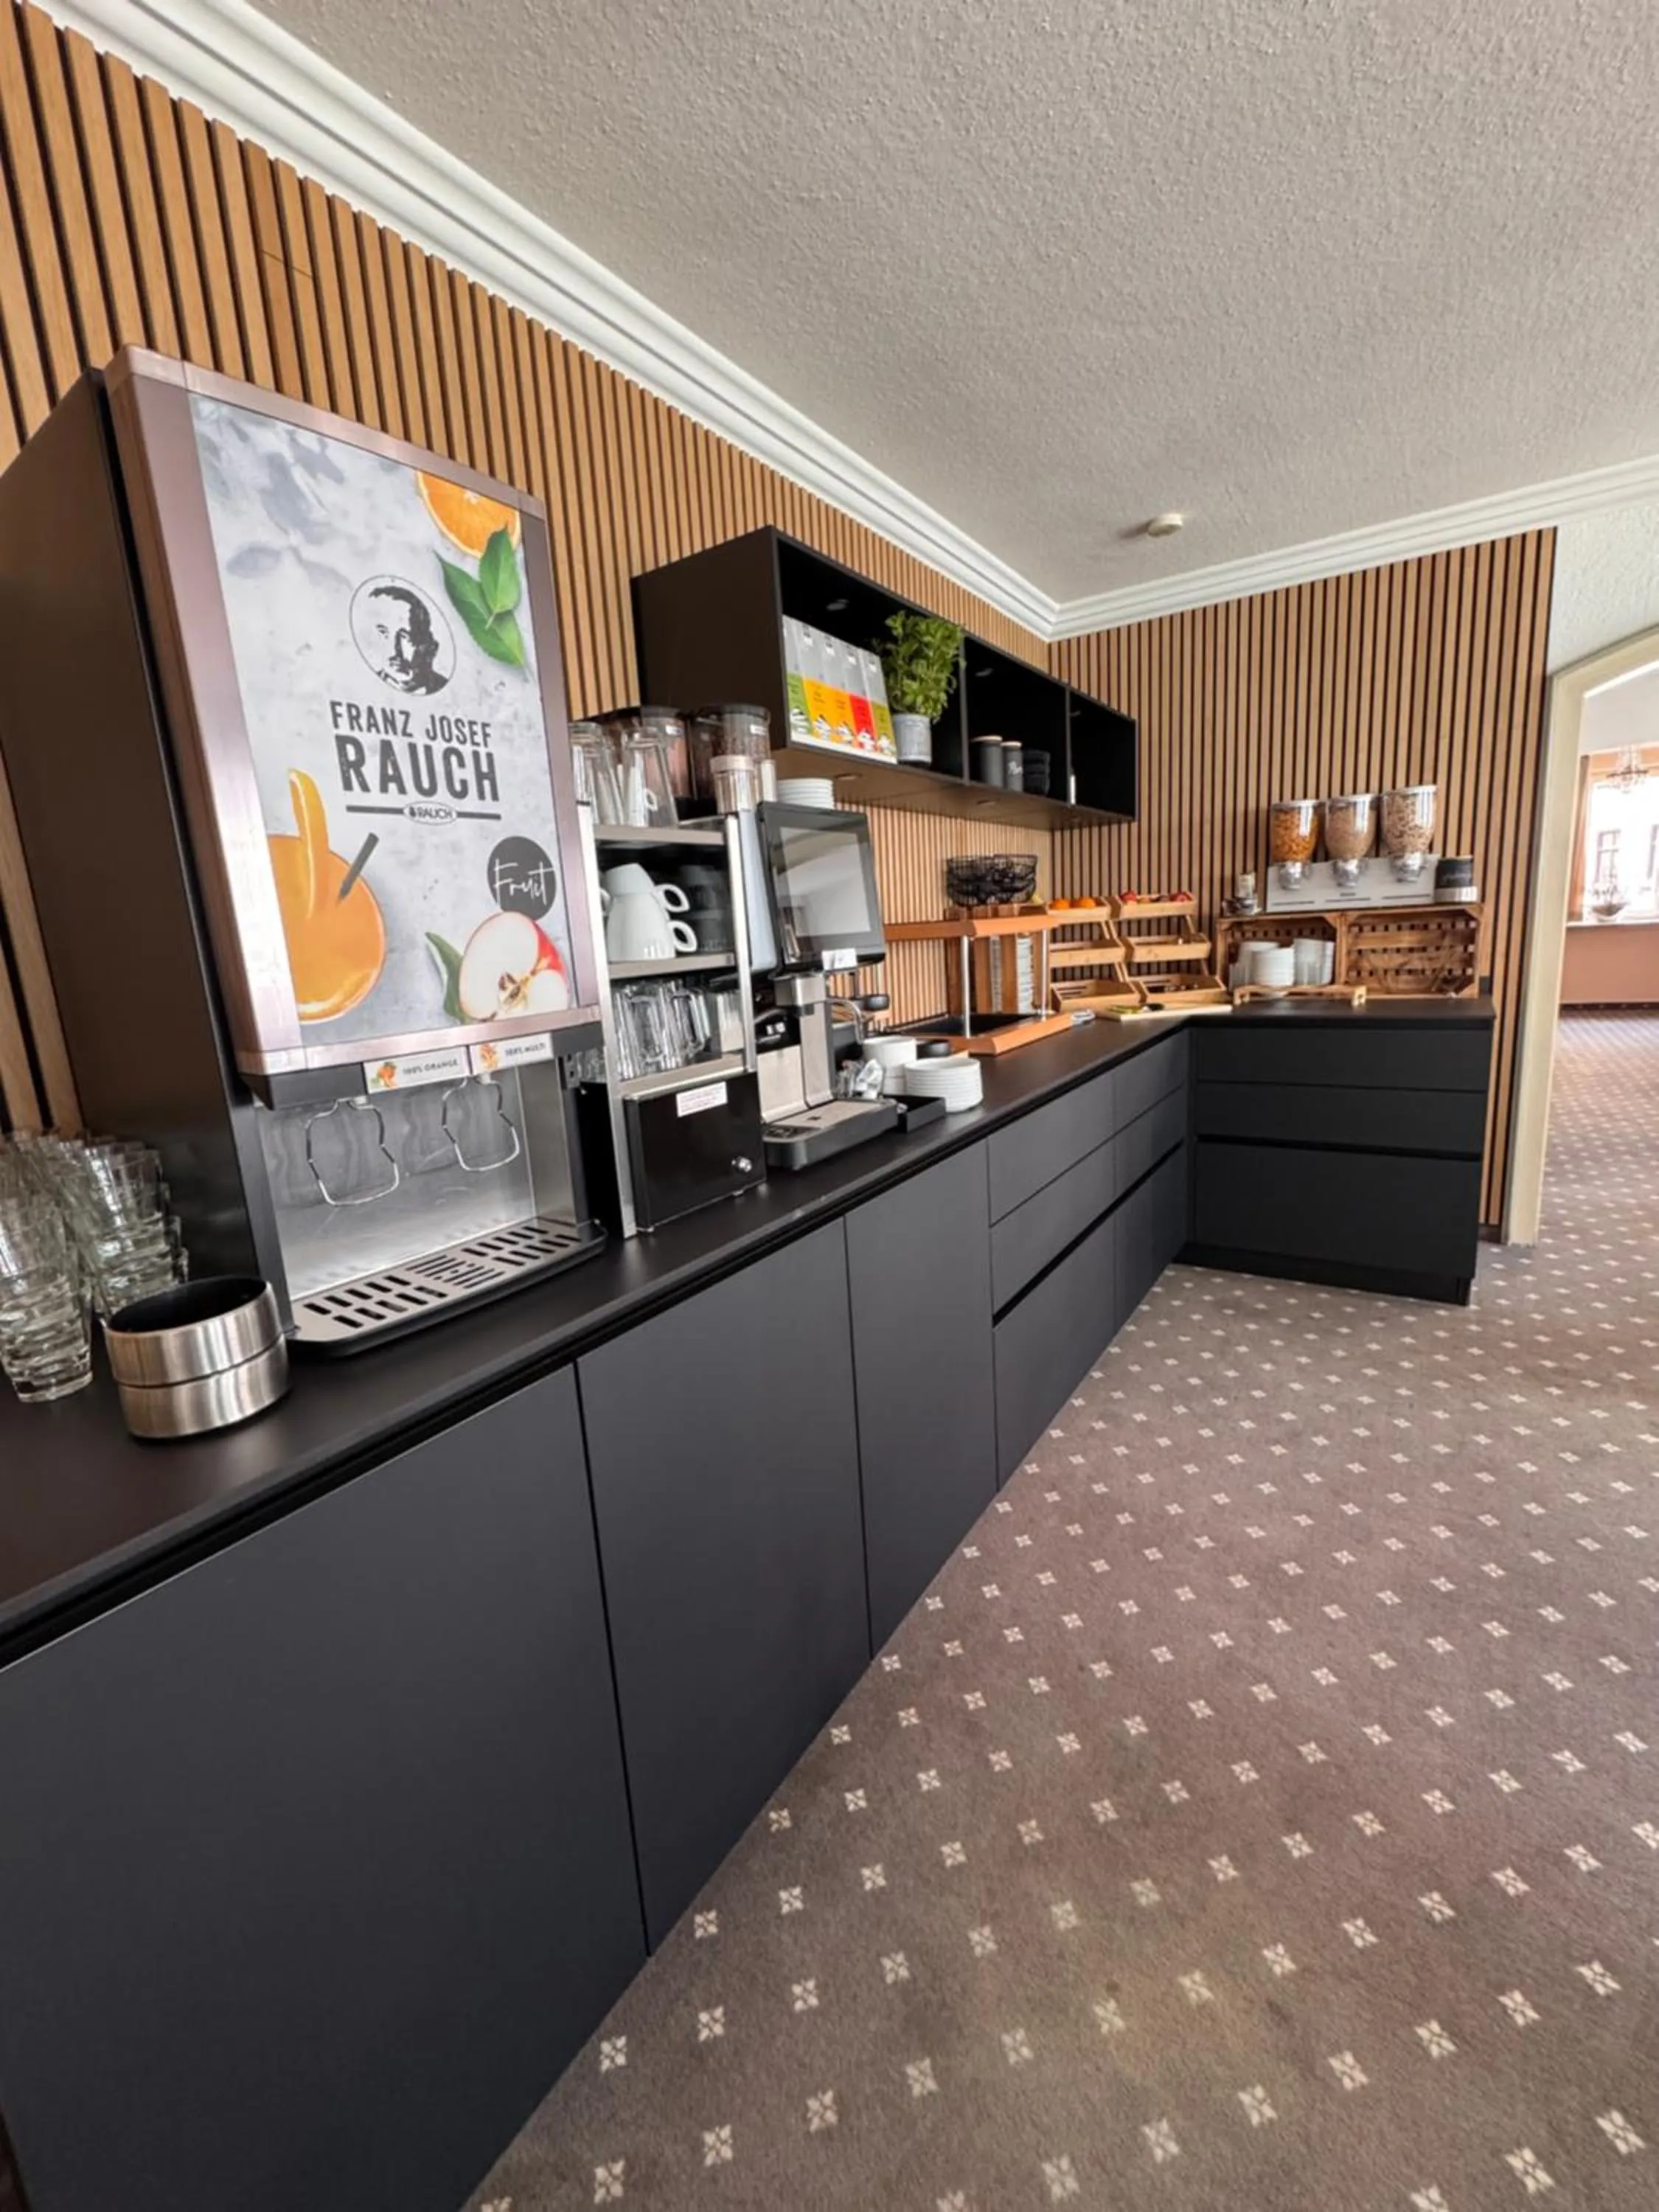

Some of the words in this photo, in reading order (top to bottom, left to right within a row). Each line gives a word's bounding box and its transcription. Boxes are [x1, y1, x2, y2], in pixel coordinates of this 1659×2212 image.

[330, 700, 414, 737] FRANZ
[425, 714, 491, 748] JOSEF
[335, 734, 499, 801] RAUCH
